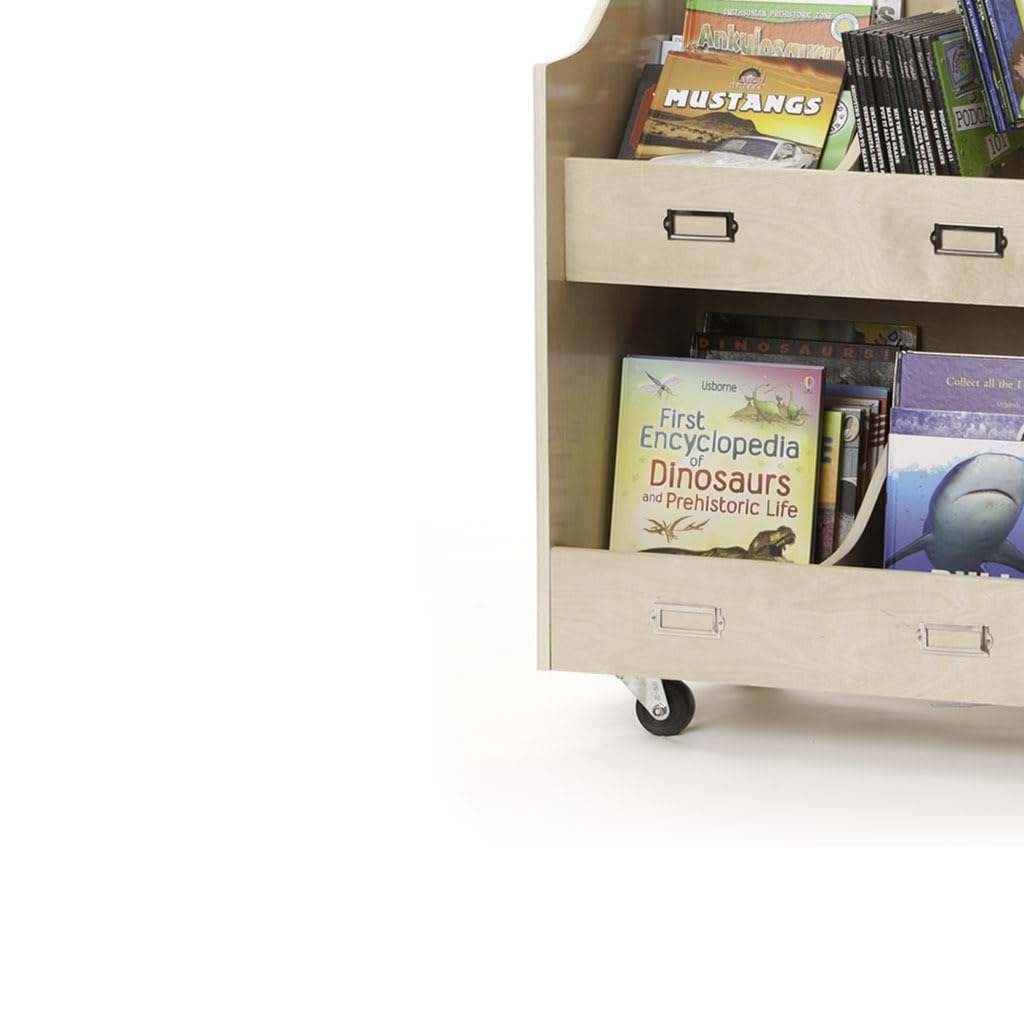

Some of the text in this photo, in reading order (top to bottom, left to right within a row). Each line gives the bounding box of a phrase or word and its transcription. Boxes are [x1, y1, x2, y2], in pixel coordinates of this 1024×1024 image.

[664, 88, 822, 116] MUSTANGS
[988, 133, 1008, 155] 101
[699, 337, 891, 360] DINOSAURS!
[702, 380, 737, 392] Usborne
[946, 377, 980, 387] Collect
[984, 378, 994, 388] all
[999, 379, 1013, 389] the
[1017, 380, 1021, 389] I
[660, 408, 705, 430] First
[640, 426, 800, 460] Encyclopedia
[690, 455, 704, 467] of
[650, 459, 791, 496] Dinosaurs
[642, 492, 798, 518] and Prehistoric Life
